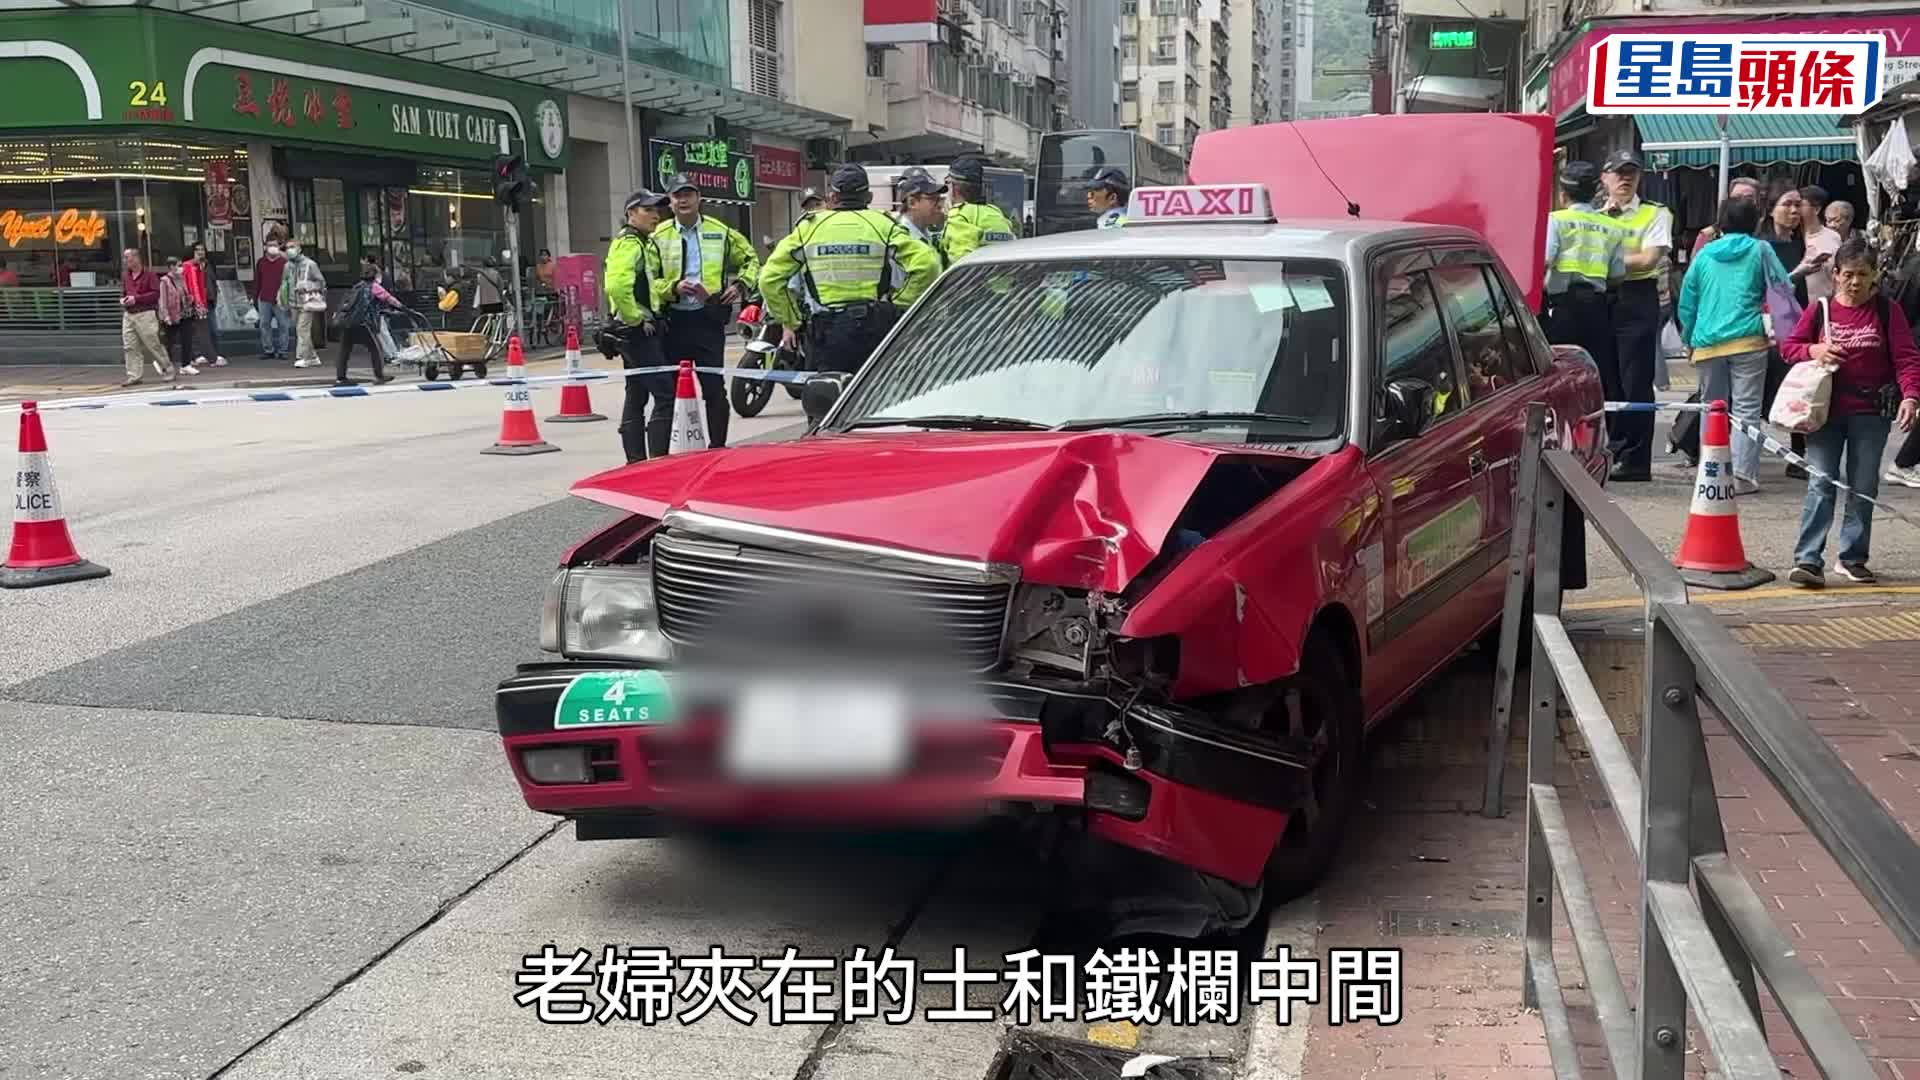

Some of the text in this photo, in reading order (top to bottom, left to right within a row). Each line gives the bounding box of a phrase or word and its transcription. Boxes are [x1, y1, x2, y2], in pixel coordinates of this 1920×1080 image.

[129, 80, 168, 107] 24
[392, 103, 497, 145] SAM YUET CAFE
[1138, 187, 1254, 217] TAXI
[56, 208, 106, 246] Cafe
[602, 679, 627, 706] 4
[578, 706, 650, 723] SEATS
